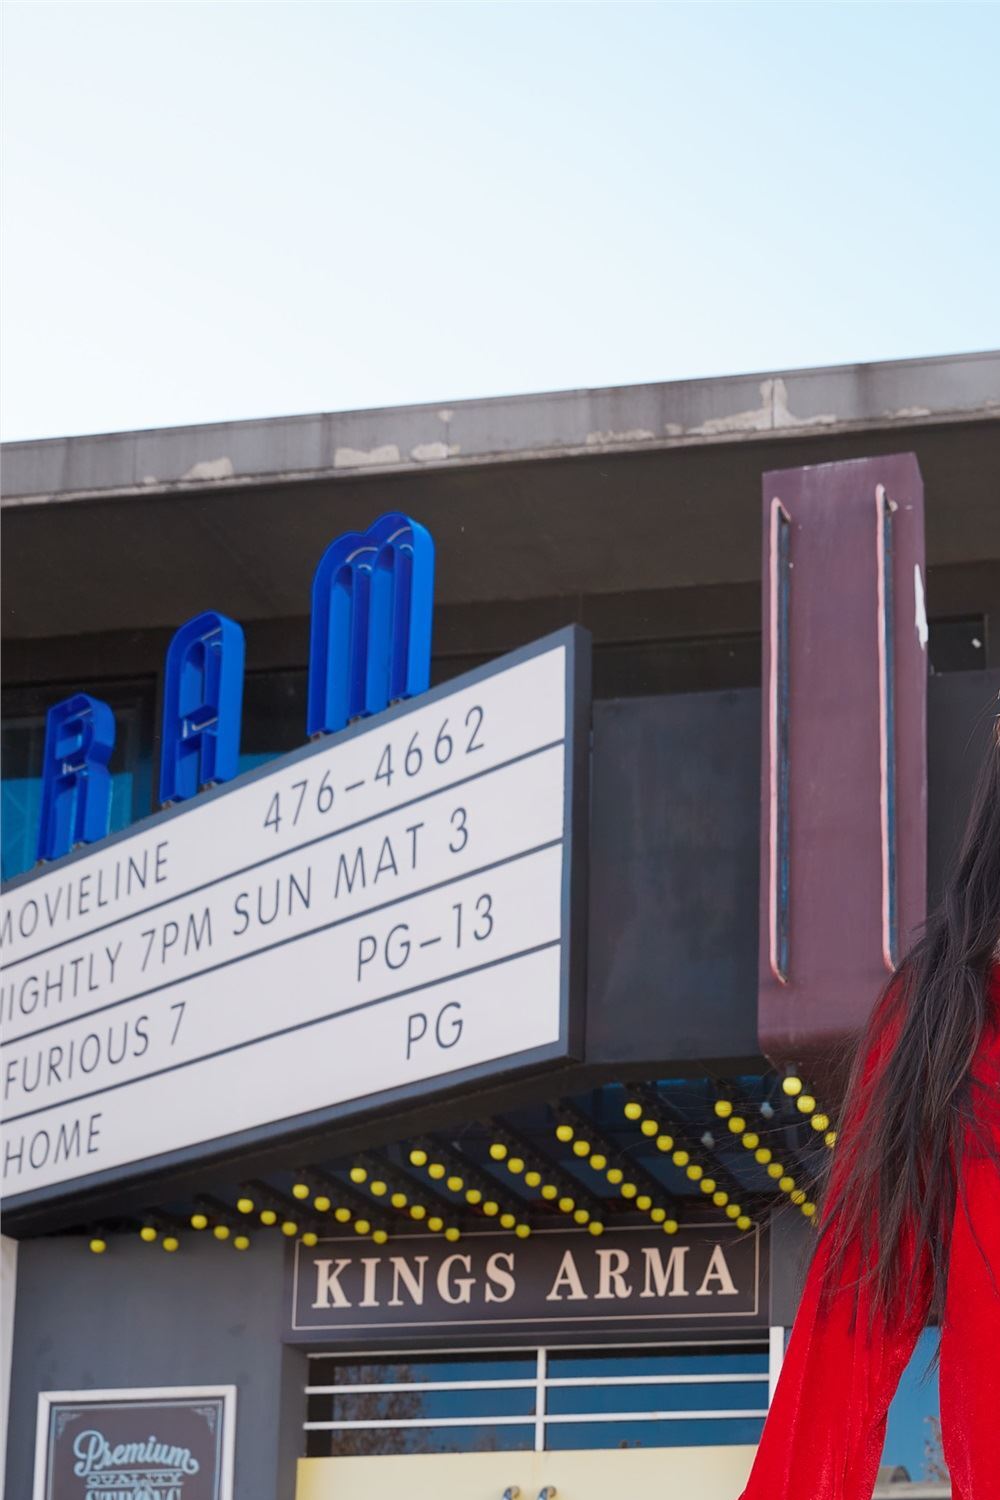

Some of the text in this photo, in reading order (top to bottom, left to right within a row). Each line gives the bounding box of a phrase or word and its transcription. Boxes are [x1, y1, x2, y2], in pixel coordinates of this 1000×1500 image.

[262, 705, 486, 833] 476-4662
[141, 904, 214, 973] 7PM
[233, 866, 312, 936] SUN
[334, 822, 426, 899] MAT
[448, 807, 470, 854] 3
[4, 893, 495, 1099] FURIOUS 7 PG-13
[3, 1002, 464, 1179] HOME PG
[311, 1244, 739, 1309] KINGS ARMA
[73, 1430, 199, 1477] Premium
